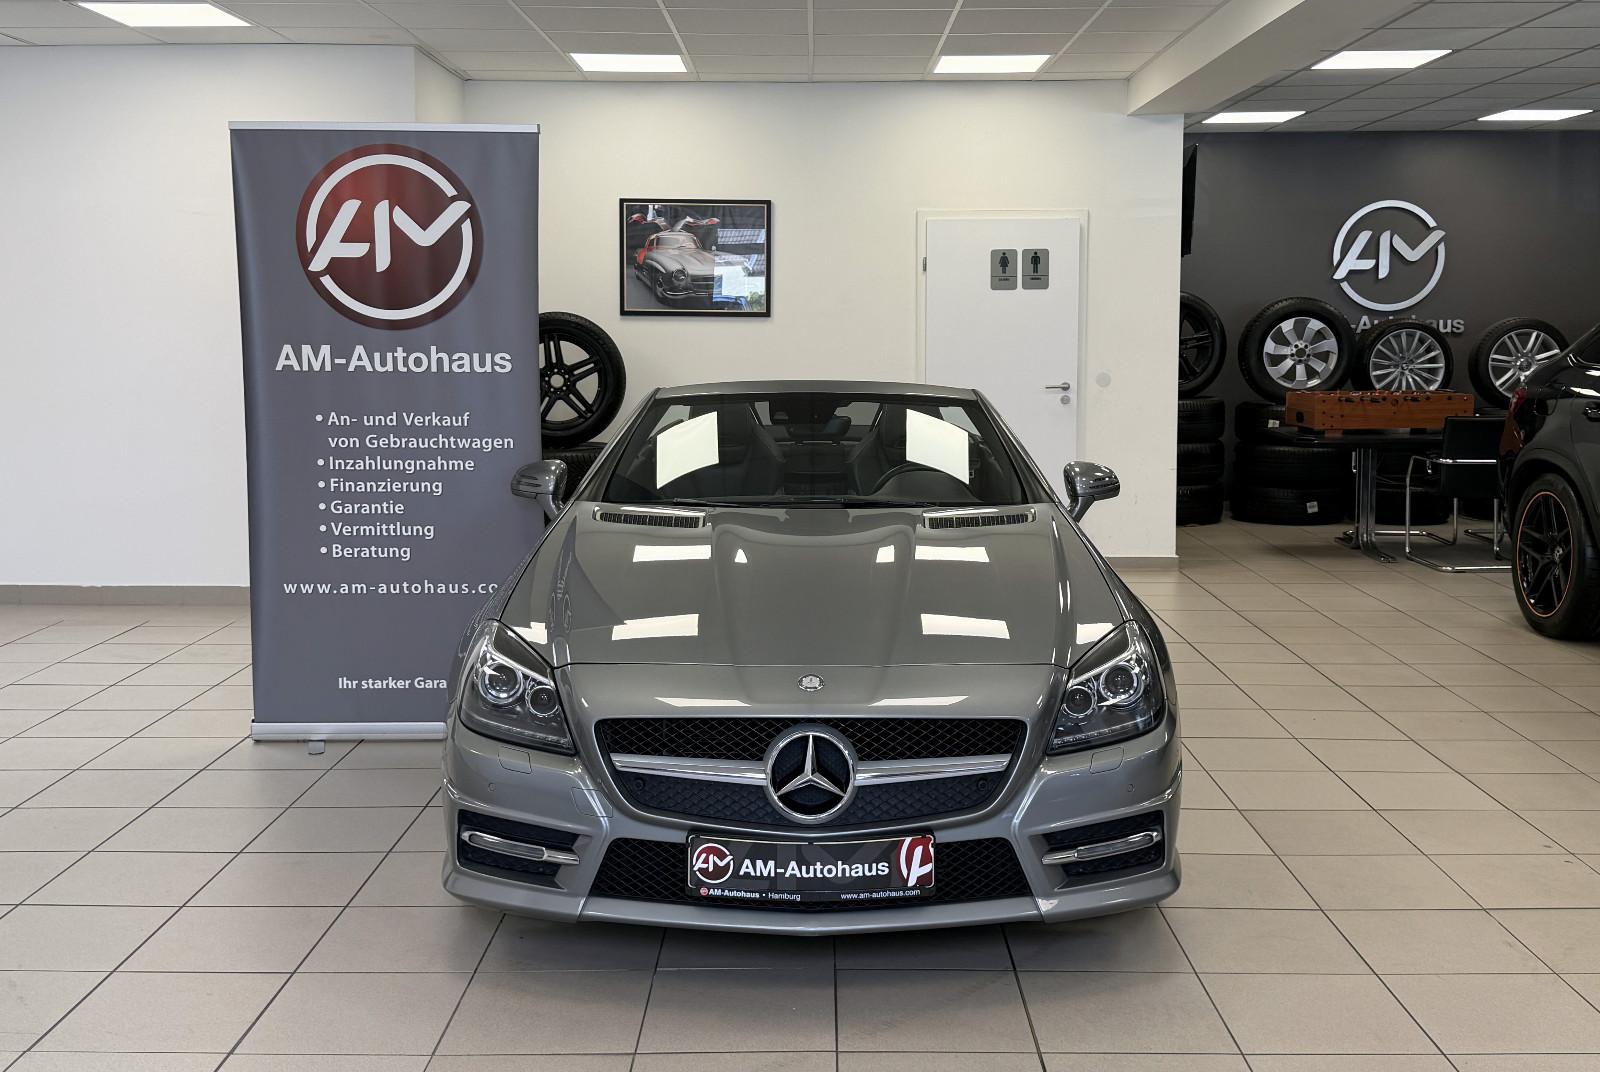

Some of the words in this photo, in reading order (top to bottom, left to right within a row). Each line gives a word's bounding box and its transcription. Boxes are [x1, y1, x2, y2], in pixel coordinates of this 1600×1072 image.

[275, 344, 513, 373] AM-Autohaus
[327, 411, 358, 426] An-
[363, 411, 397, 426] und
[402, 411, 470, 427] Verkauf
[327, 437, 360, 448] von
[365, 433, 515, 452] Gebrauchtwagen
[329, 455, 475, 474] Inzahlungnahme
[330, 478, 443, 496] Finanzierung
[330, 500, 405, 514] Garantie
[330, 521, 434, 540] Vermittlung
[332, 543, 411, 561] Beratung
[283, 580, 498, 594] www.am-autohaus.co
[338, 676, 359, 689] Ihr
[361, 676, 412, 689] starker
[414, 676, 448, 689] Gara
[738, 858, 890, 879] AM-Autohaus
[708, 888, 760, 899] AM-Autohaus
[768, 892, 801, 902] Hamburg
[840, 889, 921, 900] www.am-autohaus.com
